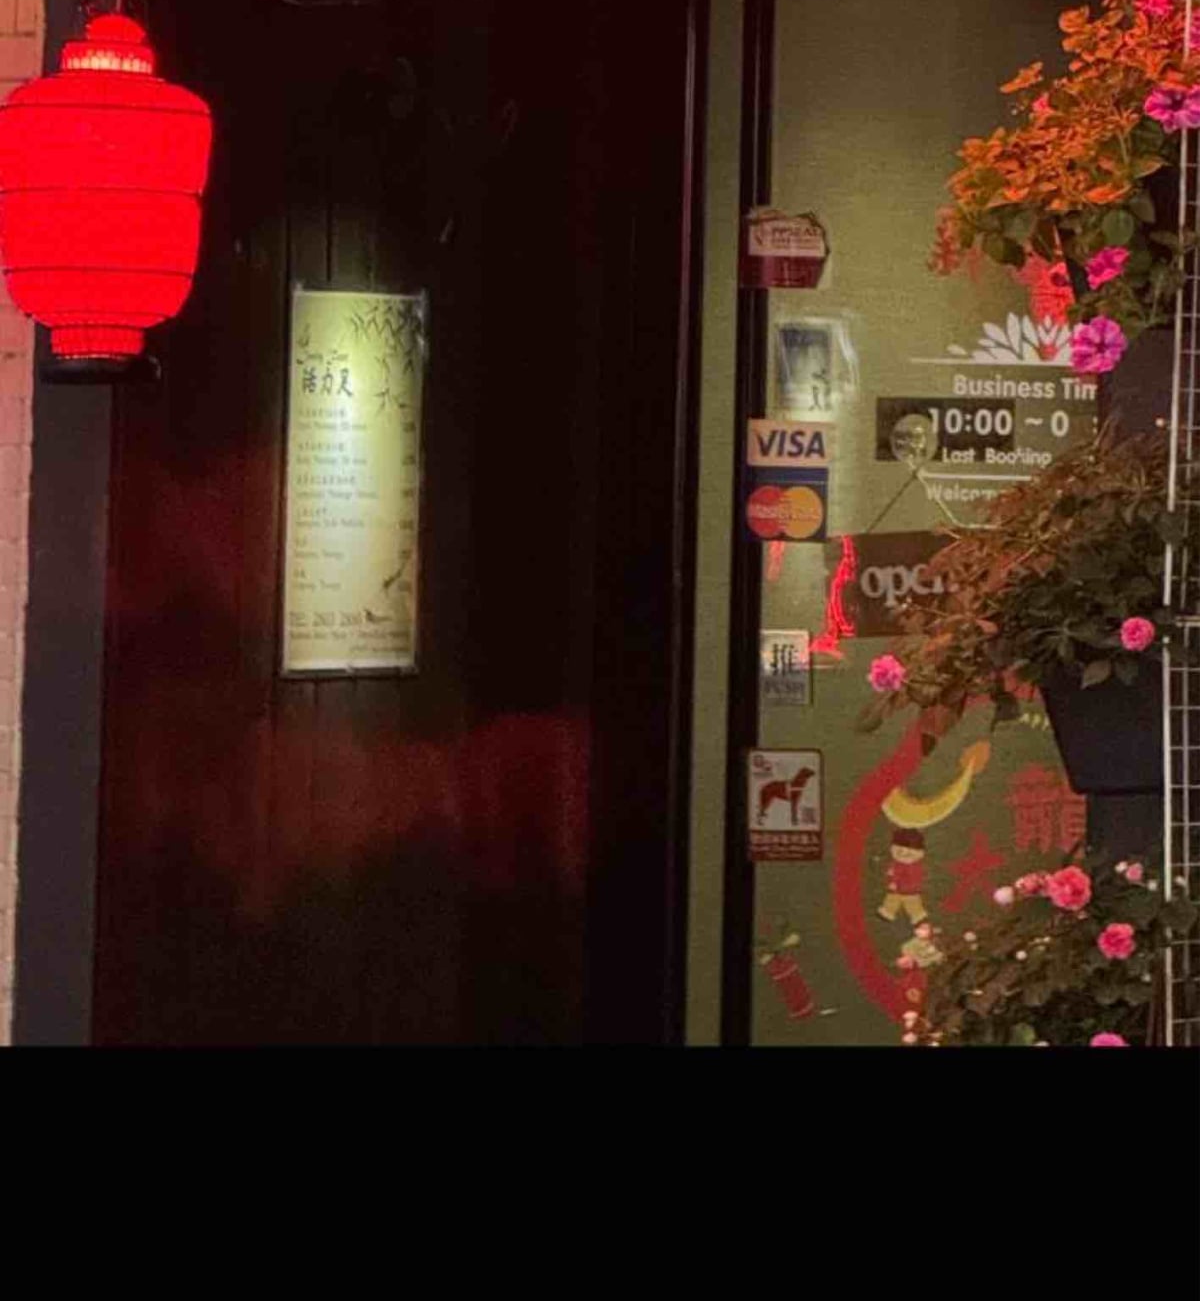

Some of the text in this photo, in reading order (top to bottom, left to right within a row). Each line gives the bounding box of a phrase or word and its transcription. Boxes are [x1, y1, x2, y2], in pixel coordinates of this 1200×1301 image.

[953, 374, 1056, 398] Business
[928, 407, 1012, 436] 10:00
[756, 429, 825, 458] VISA
[942, 448, 976, 463] Last
[860, 563, 946, 607] ope
